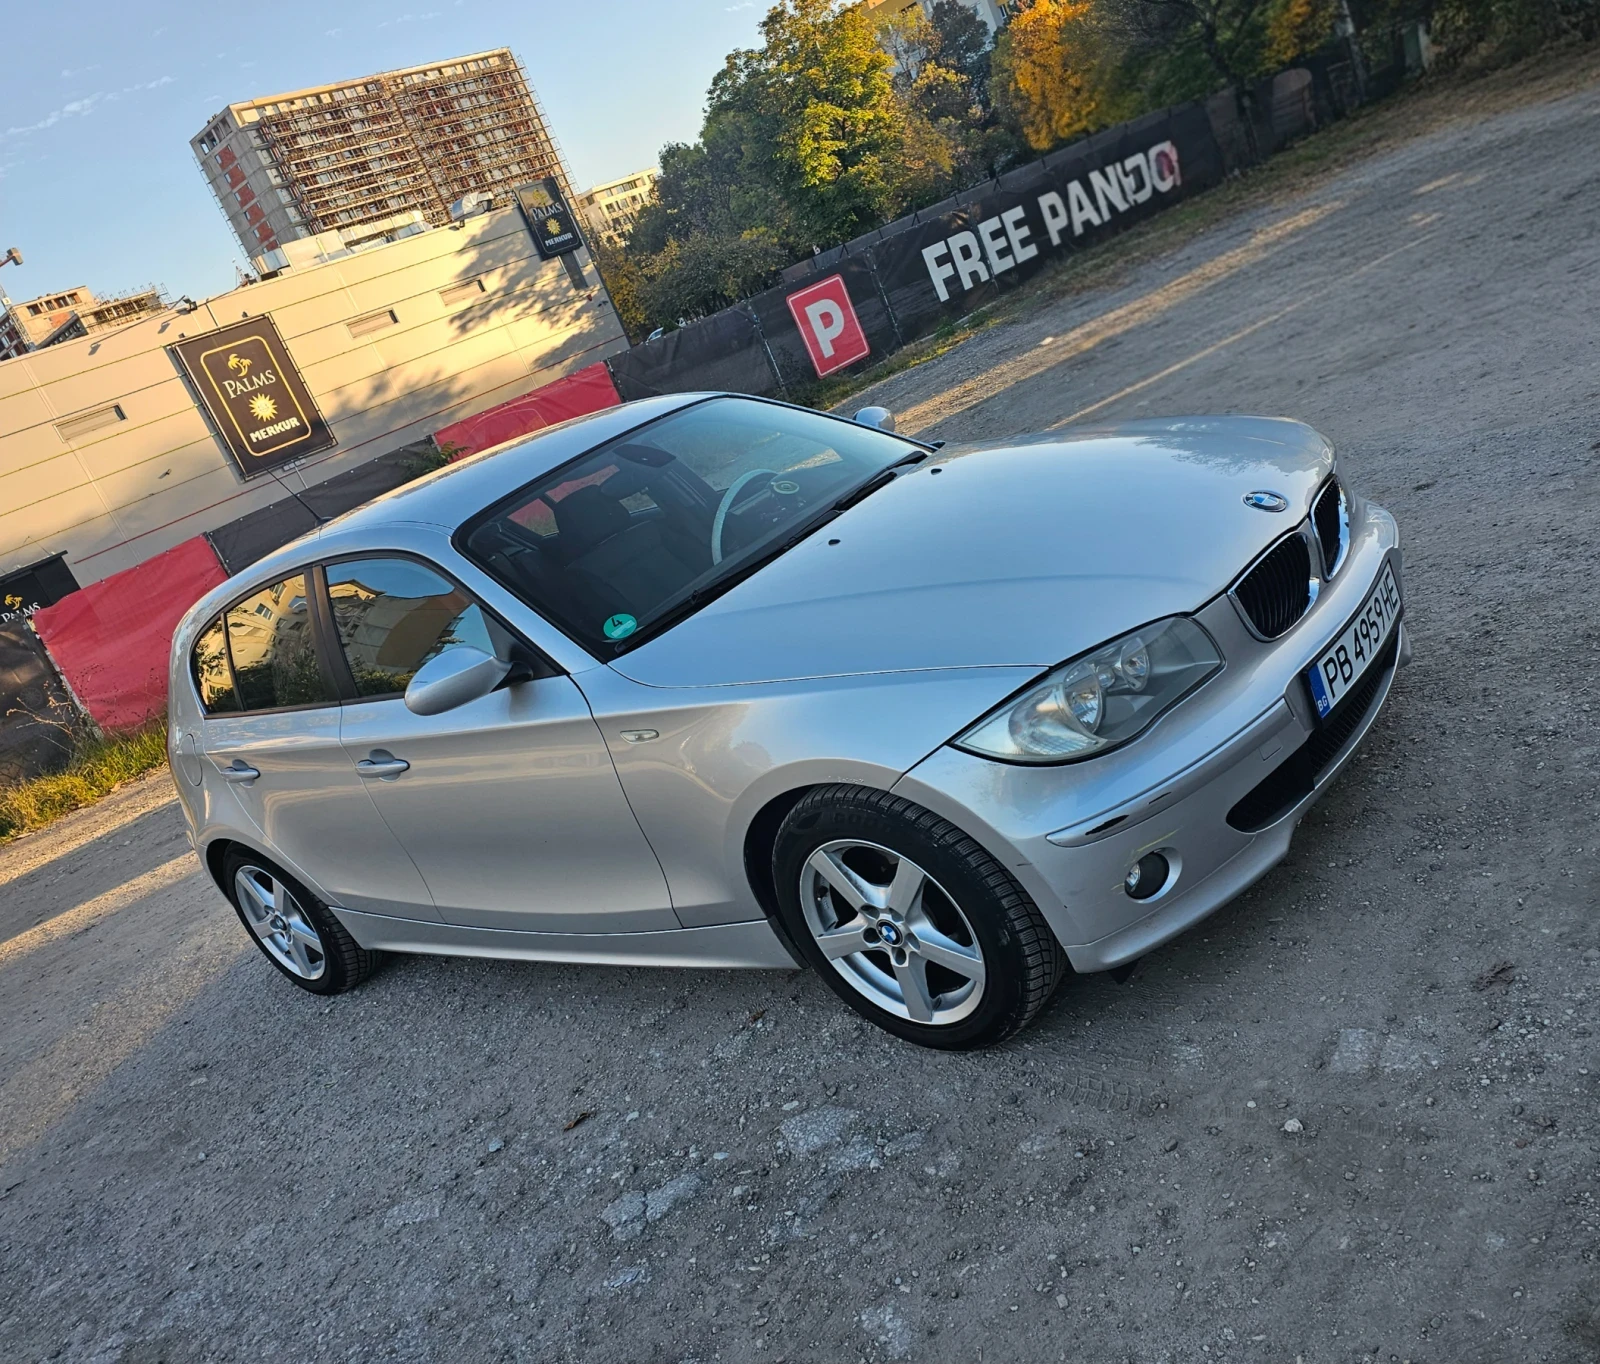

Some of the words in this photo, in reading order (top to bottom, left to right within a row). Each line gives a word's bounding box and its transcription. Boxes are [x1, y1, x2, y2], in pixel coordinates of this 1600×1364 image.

[532, 202, 564, 221] PALMS
[545, 232, 573, 247] MERKUR
[922, 205, 1038, 302] FREE
[804, 299, 845, 359] P
[222, 370, 276, 399] PALMS
[249, 417, 300, 443] MERKUR
[611, 617, 623, 627] 4
[1323, 644, 1353, 699] PB
[1353, 598, 1386, 663] 4959
[1380, 571, 1398, 621] HE
[1317, 695, 1328, 712] BG
